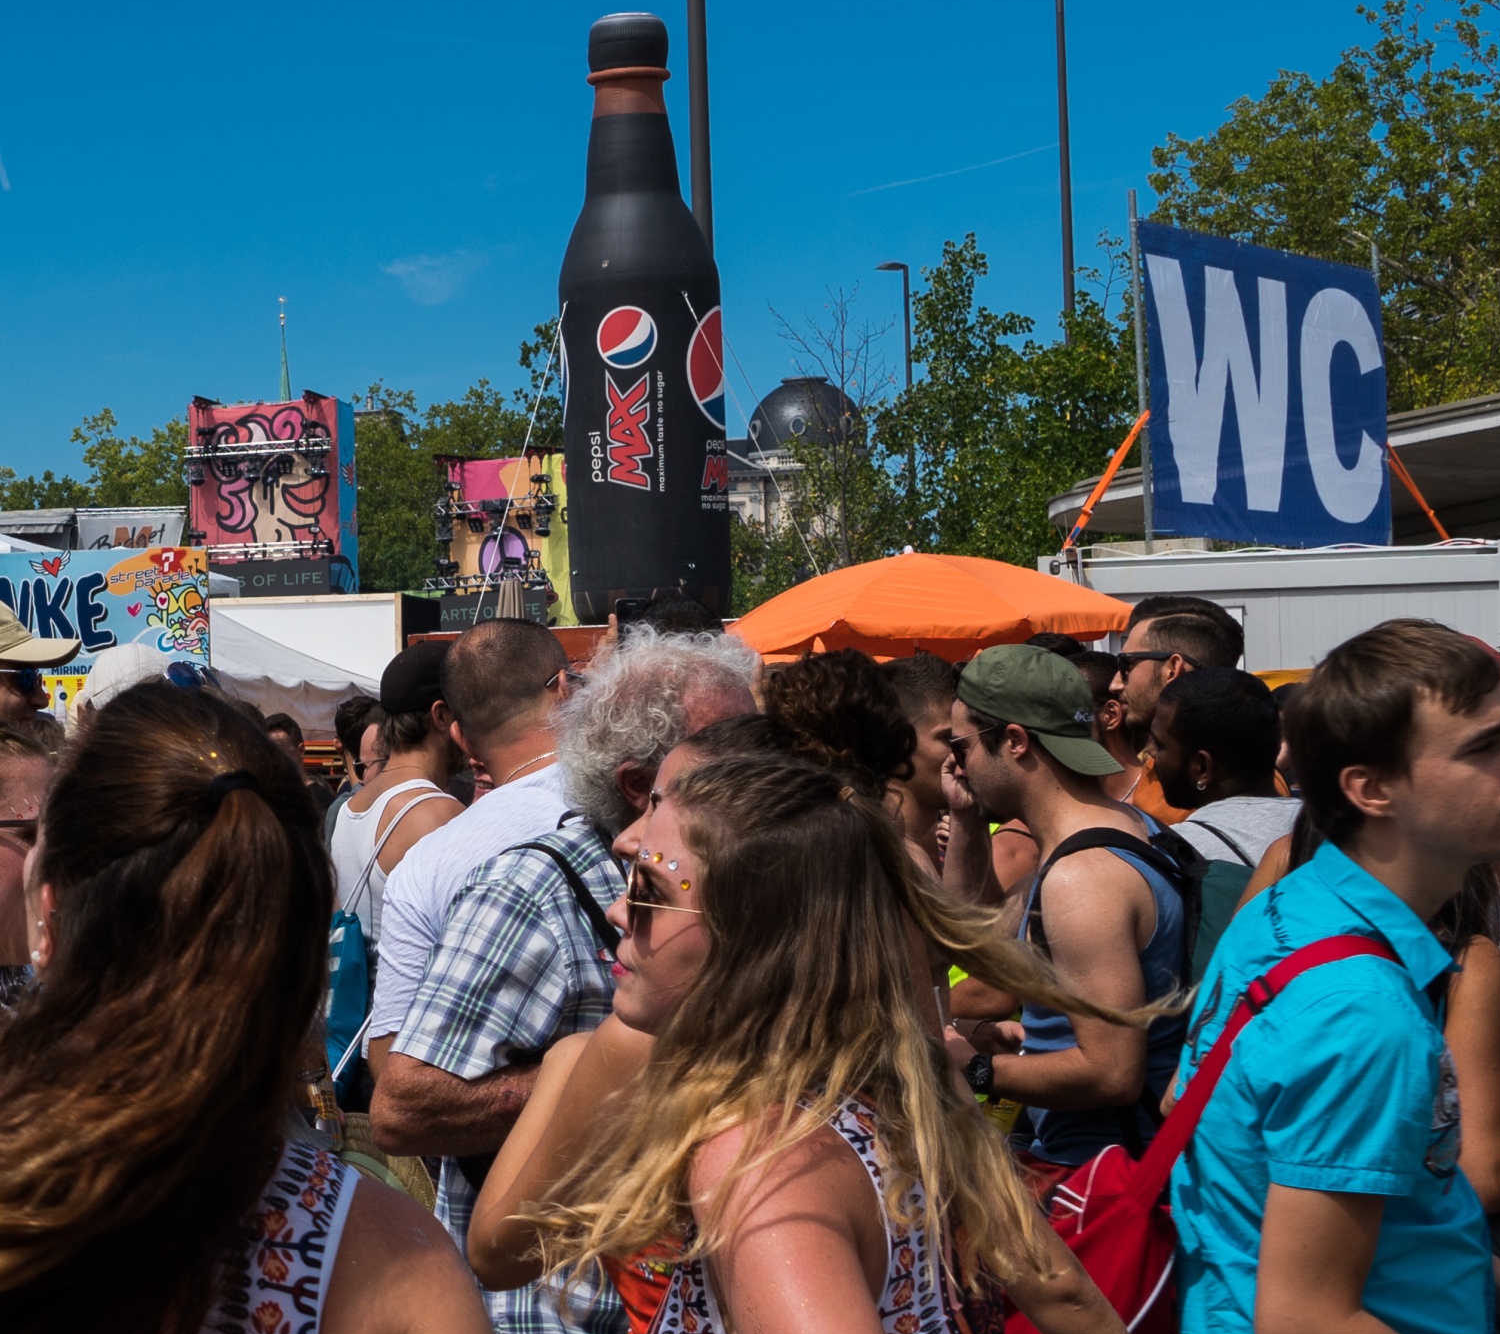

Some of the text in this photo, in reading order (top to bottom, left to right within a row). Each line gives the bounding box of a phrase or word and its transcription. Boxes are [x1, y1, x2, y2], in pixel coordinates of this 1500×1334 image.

[657, 370, 665, 399] sugar
[1145, 253, 1383, 524] WC
[657, 400, 664, 413] no
[605, 369, 653, 491] MAX
[588, 431, 605, 483] pepsi
[706, 439, 725, 452] peps
[657, 444, 665, 492] maximum
[701, 455, 728, 492] MA
[701, 492, 728, 501] maximu
[712, 502, 726, 511] suga
[89, 523, 166, 549] Bdget
[110, 565, 162, 584] street
[135, 569, 190, 592] parade
[253, 574, 277, 587] OF
[284, 572, 322, 586] LIFE
[440, 607, 477, 622] ARTS
